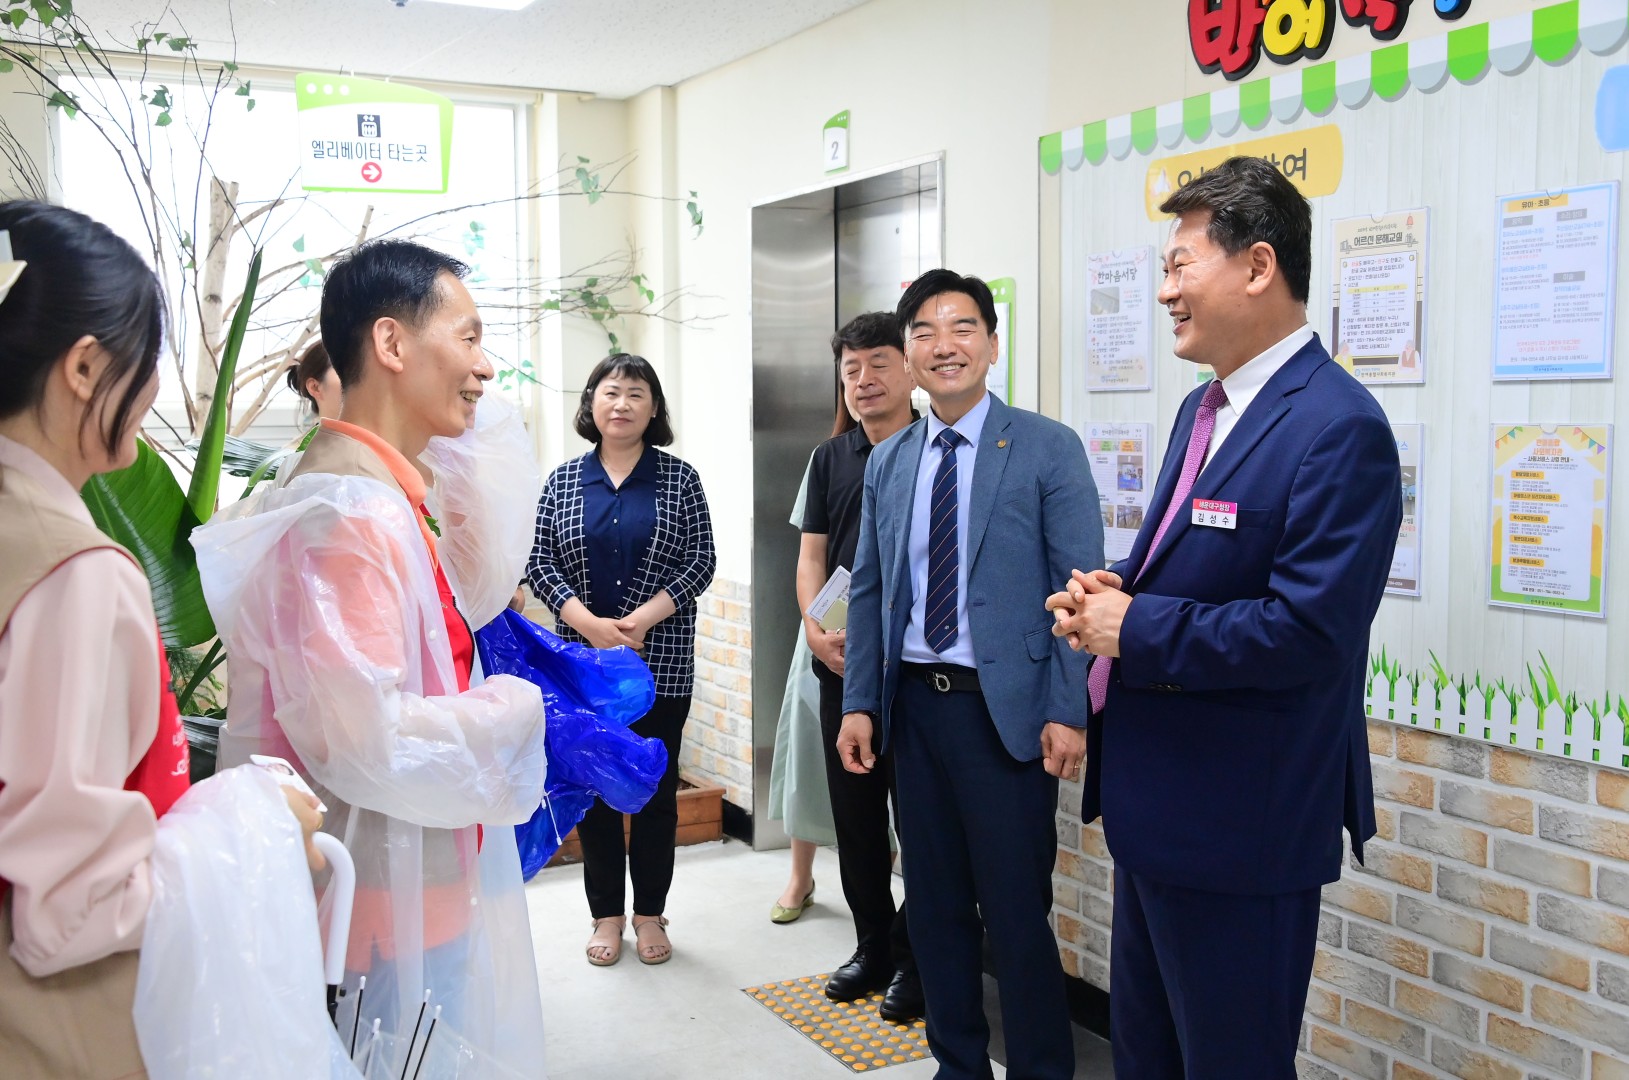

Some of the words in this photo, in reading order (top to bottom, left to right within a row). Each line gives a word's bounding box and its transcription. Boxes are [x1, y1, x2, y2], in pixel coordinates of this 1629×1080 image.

[311, 140, 382, 160] 엘리베이터
[388, 143, 428, 162] 타는곳
[831, 141, 839, 160] 2
[1354, 235, 1375, 246] 어르신
[1376, 232, 1403, 245] 문해교실
[1097, 267, 1138, 284] 한마음서당
[1198, 501, 1230, 512] 해운대구청장
